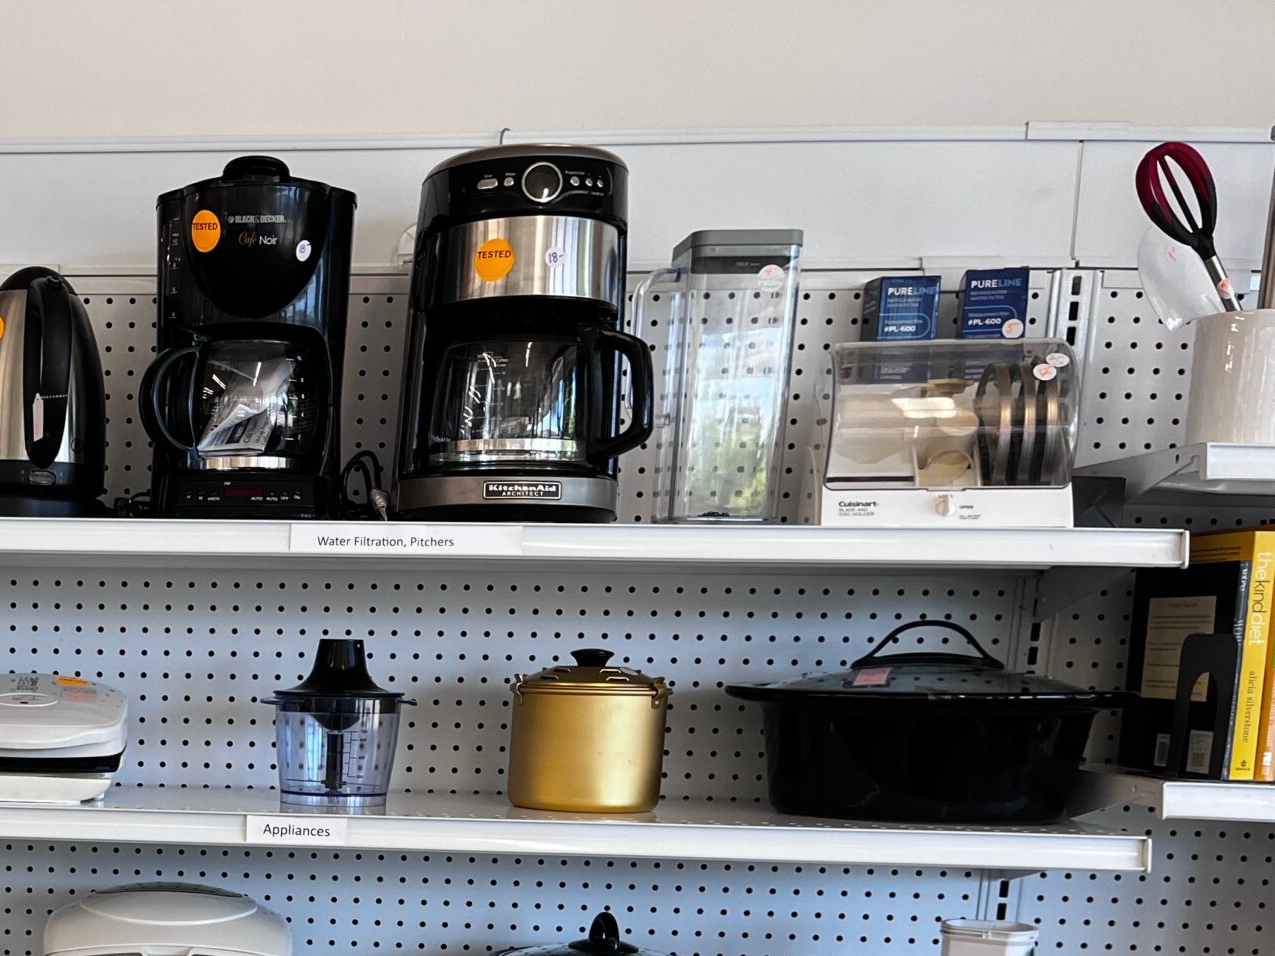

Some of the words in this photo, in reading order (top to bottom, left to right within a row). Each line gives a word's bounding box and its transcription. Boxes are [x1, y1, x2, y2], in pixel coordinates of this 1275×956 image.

[193, 222, 218, 231] TESTED
[259, 235, 278, 245] Noir
[477, 250, 511, 259] TESTED
[971, 279, 1022, 289] PURELINE
[888, 286, 937, 296] PURELINE
[968, 318, 1002, 326] #PL-600
[489, 484, 556, 492] KitchenAid
[317, 536, 350, 547] Water
[354, 536, 407, 549] Filtration,
[410, 537, 454, 547] Pitchers
[1246, 671, 1257, 694] alicia
[1242, 697, 1255, 743] silverstone
[263, 823, 330, 838] Appliances
